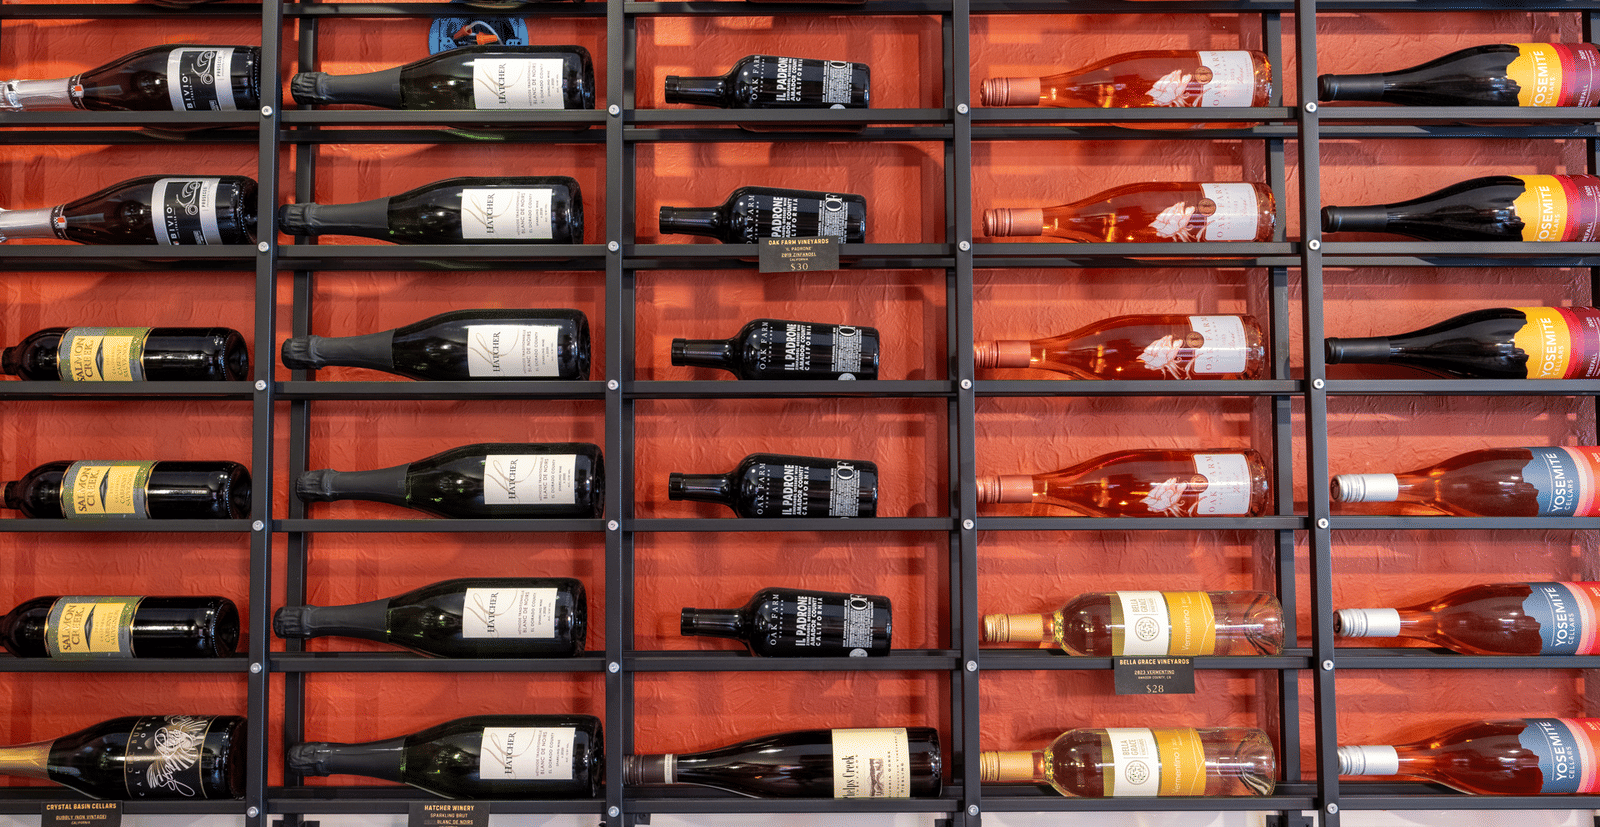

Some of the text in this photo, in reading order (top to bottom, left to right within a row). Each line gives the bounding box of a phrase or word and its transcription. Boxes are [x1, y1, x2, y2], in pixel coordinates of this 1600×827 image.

[182, 76, 194, 109] BIVIO
[498, 63, 507, 104] HATCHER
[531, 78, 537, 86] DE
[751, 78, 759, 100] OAK
[776, 57, 788, 101] IL PADRONE
[1545, 75, 1556, 105] ELLARS
[166, 206, 178, 240] BIVIO
[486, 192, 496, 234] HATCHER
[520, 208, 525, 216] DE
[747, 195, 756, 221] FARM
[772, 197, 784, 237] PADRONE
[1538, 185, 1554, 242] OSEMITE
[1550, 213, 1561, 240] ELLARS
[790, 263, 809, 271] $30
[492, 331, 501, 373] HATCHER
[526, 347, 531, 355] DE
[759, 349, 767, 370] OAK
[785, 323, 797, 371] IL PADRONE
[1539, 317, 1557, 378] YOSEMITE
[1553, 345, 1565, 376] CELLARS
[77, 466, 92, 512] SALMON
[508, 458, 518, 499] HATCHER
[543, 473, 548, 481] DE
[757, 463, 767, 515] OAK FARM
[782, 464, 795, 506] PADRONE
[1545, 453, 1566, 512] YOSEMITE
[1564, 479, 1574, 511] CELLARS
[61, 604, 77, 651] SALMON
[487, 591, 499, 633] HATCHER
[522, 607, 529, 615] DE
[769, 593, 780, 646] OAK FARM
[795, 595, 808, 646] IL PADRONE
[1544, 587, 1568, 647] YOSEMITE
[1567, 612, 1576, 645] CELLARS
[1181, 609, 1191, 651] Vermentino
[1146, 684, 1164, 693] $28
[504, 732, 517, 775] HATCHER
[540, 748, 546, 756] DE
[1121, 740, 1131, 756] BELLA
[1129, 739, 1139, 756] GRACE
[1539, 722, 1568, 781] YOSEMITE
[1566, 746, 1576, 779] CELLARS
[841, 755, 855, 778] Creek
[1171, 751, 1182, 793] Vermentino
